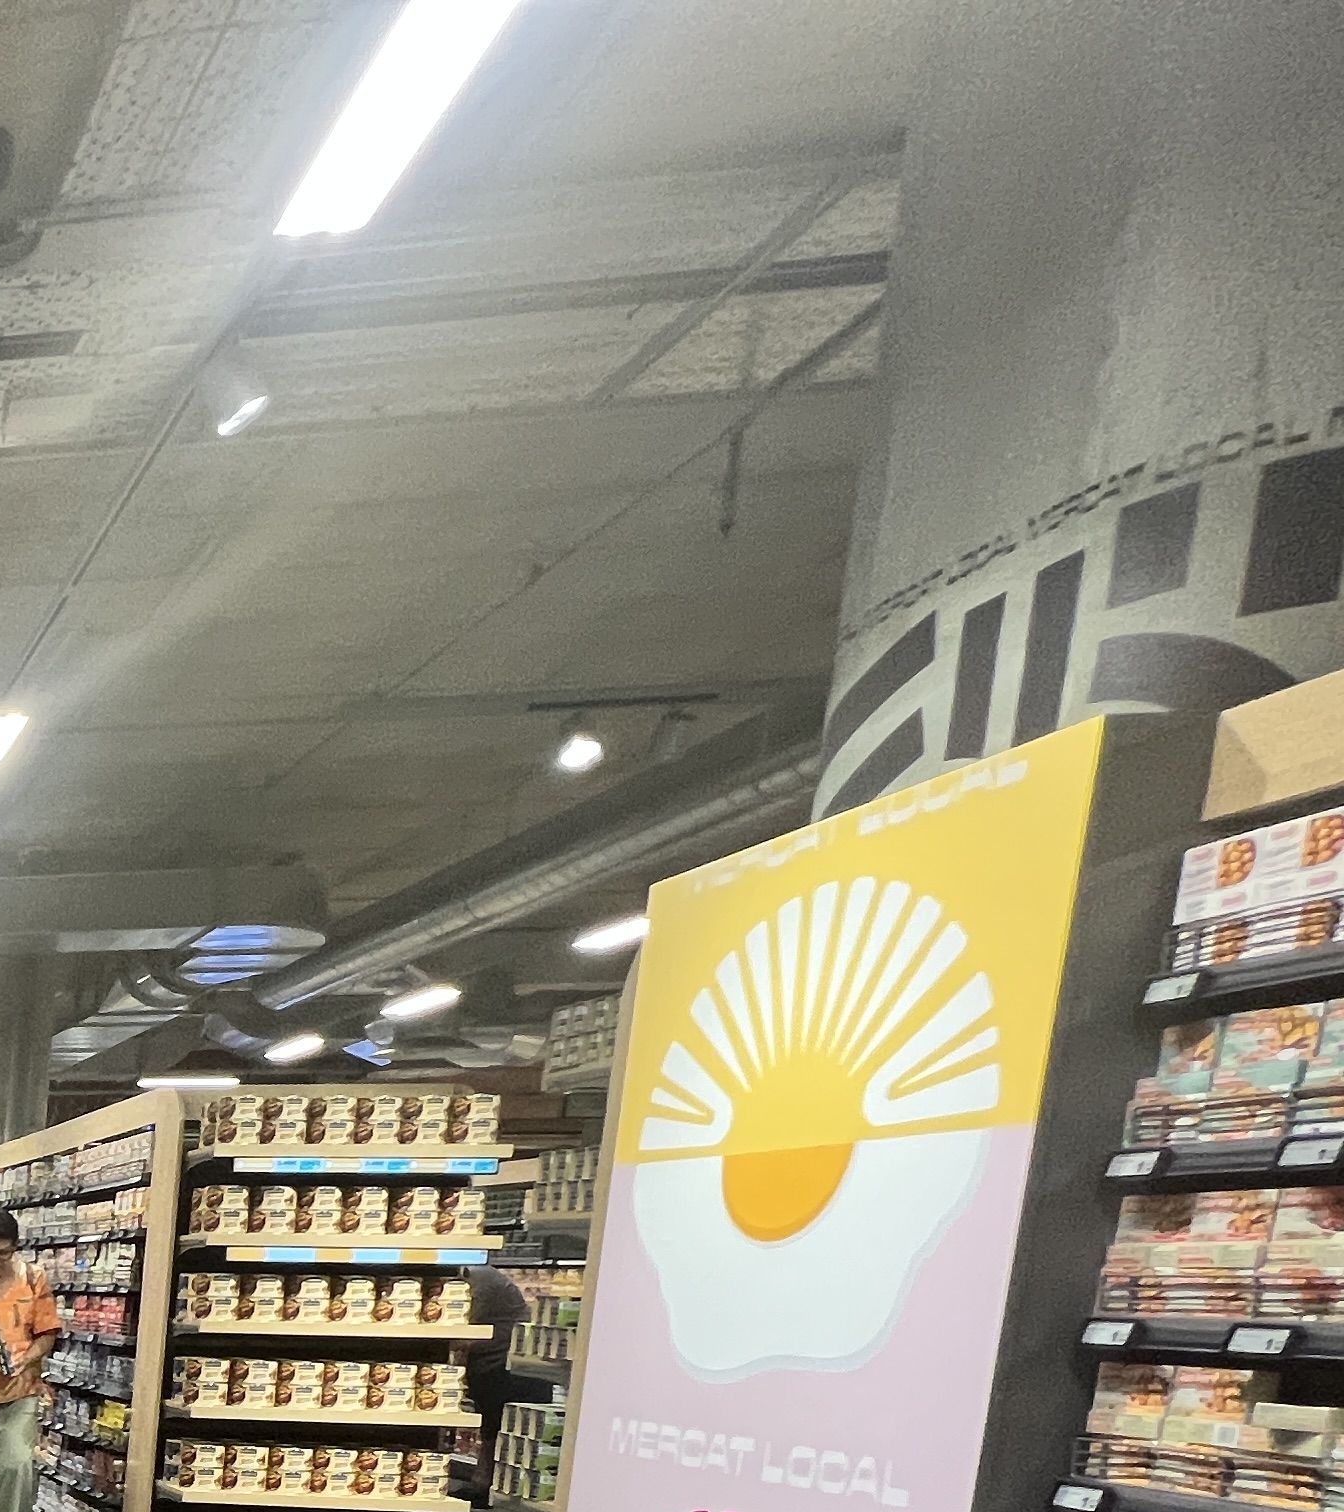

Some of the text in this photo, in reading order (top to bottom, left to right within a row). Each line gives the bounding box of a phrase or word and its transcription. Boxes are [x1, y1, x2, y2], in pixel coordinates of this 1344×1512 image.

[1153, 422, 1310, 486] LOCAL
[609, 1416, 910, 1508] MERCAT LOCAL
